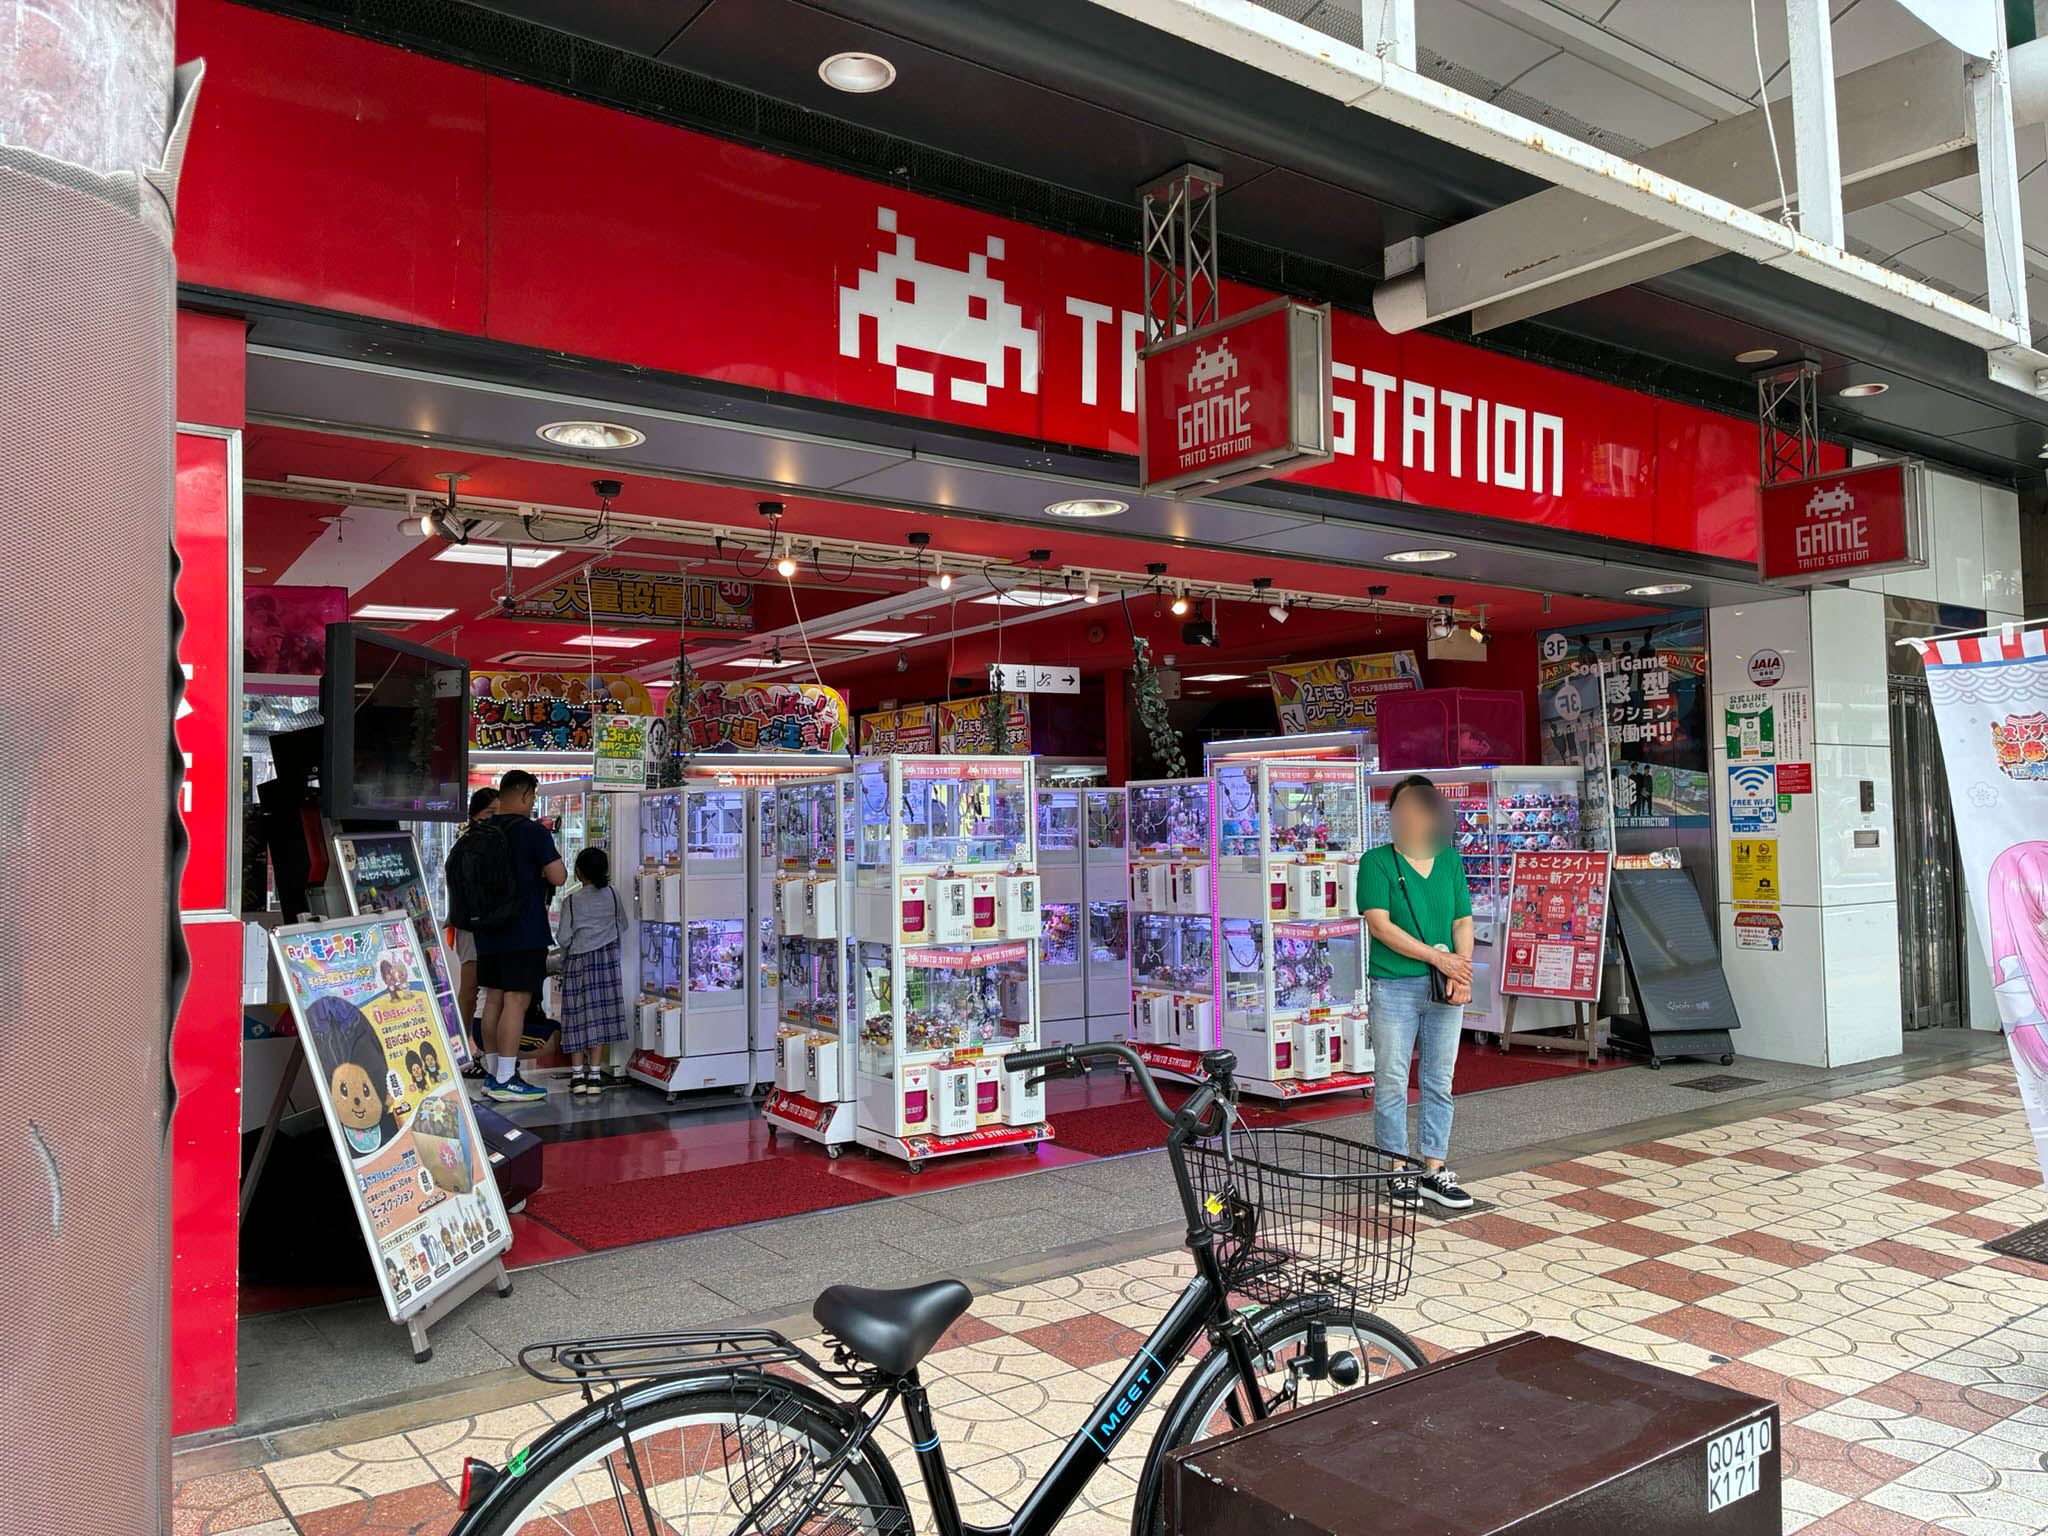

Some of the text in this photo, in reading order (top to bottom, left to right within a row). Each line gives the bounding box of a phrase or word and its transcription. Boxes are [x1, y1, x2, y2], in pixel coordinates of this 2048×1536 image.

[1177, 385, 1251, 451] GAME
[1332, 361, 1563, 497] STATION
[1179, 436, 1251, 468] TAITO STATION
[1796, 517, 1868, 557] GAME
[1798, 550, 1869, 568] TAITO STATION
[1547, 639, 1565, 656] 3F
[1620, 656, 1668, 672] Game
[1751, 657, 1780, 669] JAIA
[917, 768, 936, 776] TAITO
[1437, 786, 1469, 798] TATION
[1518, 856, 1605, 869] まるごとタイトー
[919, 955, 964, 965] TAITO STATION
[983, 946, 1025, 962] TAITO STATION
[1101, 1369, 1150, 1436] MEET
[1709, 1420, 1770, 1473] Q0410
[1710, 1460, 1755, 1509] K171
